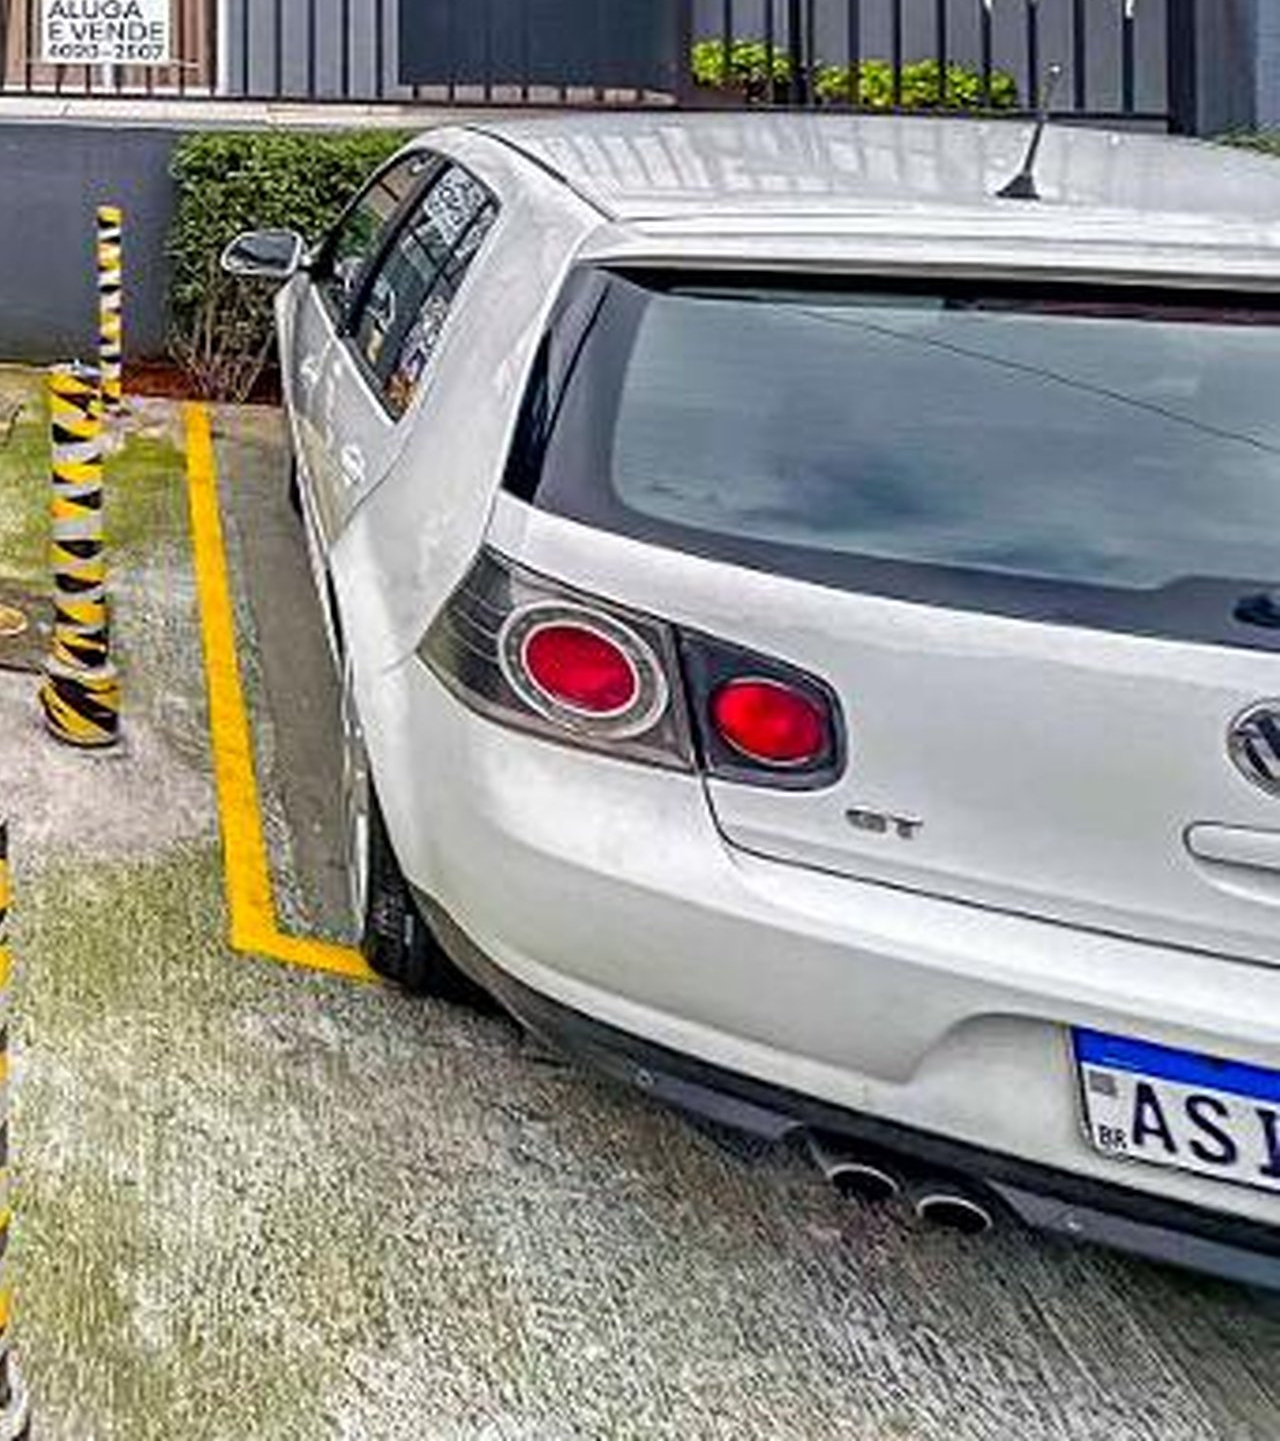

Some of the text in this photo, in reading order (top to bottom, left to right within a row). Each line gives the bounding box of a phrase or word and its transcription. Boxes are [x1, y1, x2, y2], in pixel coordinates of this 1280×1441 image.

[47, 21, 166, 42] E VENDE
[845, 809, 924, 840] GT
